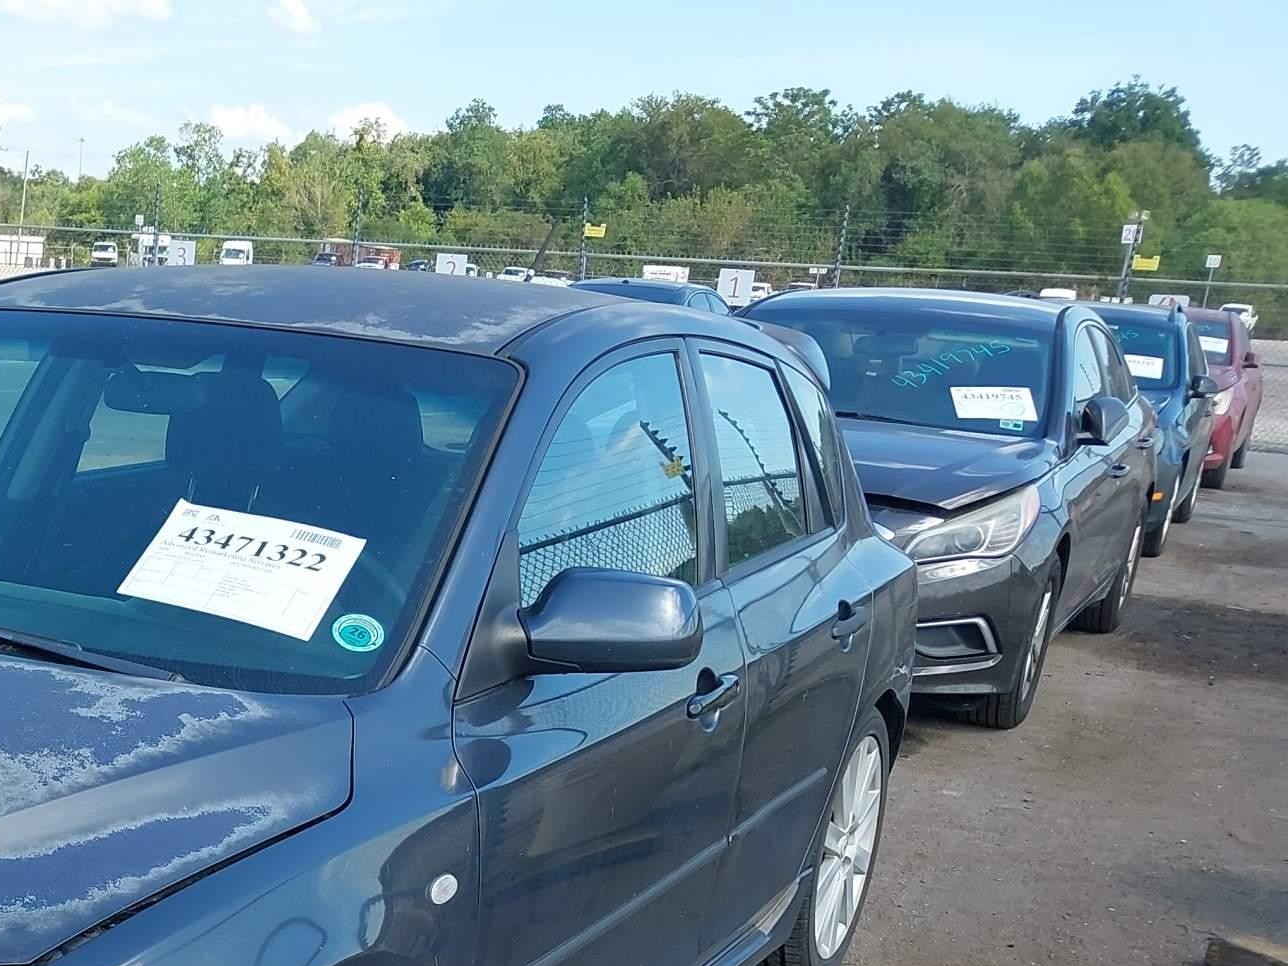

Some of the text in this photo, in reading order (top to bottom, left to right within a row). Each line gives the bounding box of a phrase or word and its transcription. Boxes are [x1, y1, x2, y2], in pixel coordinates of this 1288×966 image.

[177, 247, 186, 265] 3
[727, 276, 740, 299] 1
[891, 339, 1010, 388] 43419745
[177, 526, 327, 572] 43471322
[348, 626, 368, 639] 26
